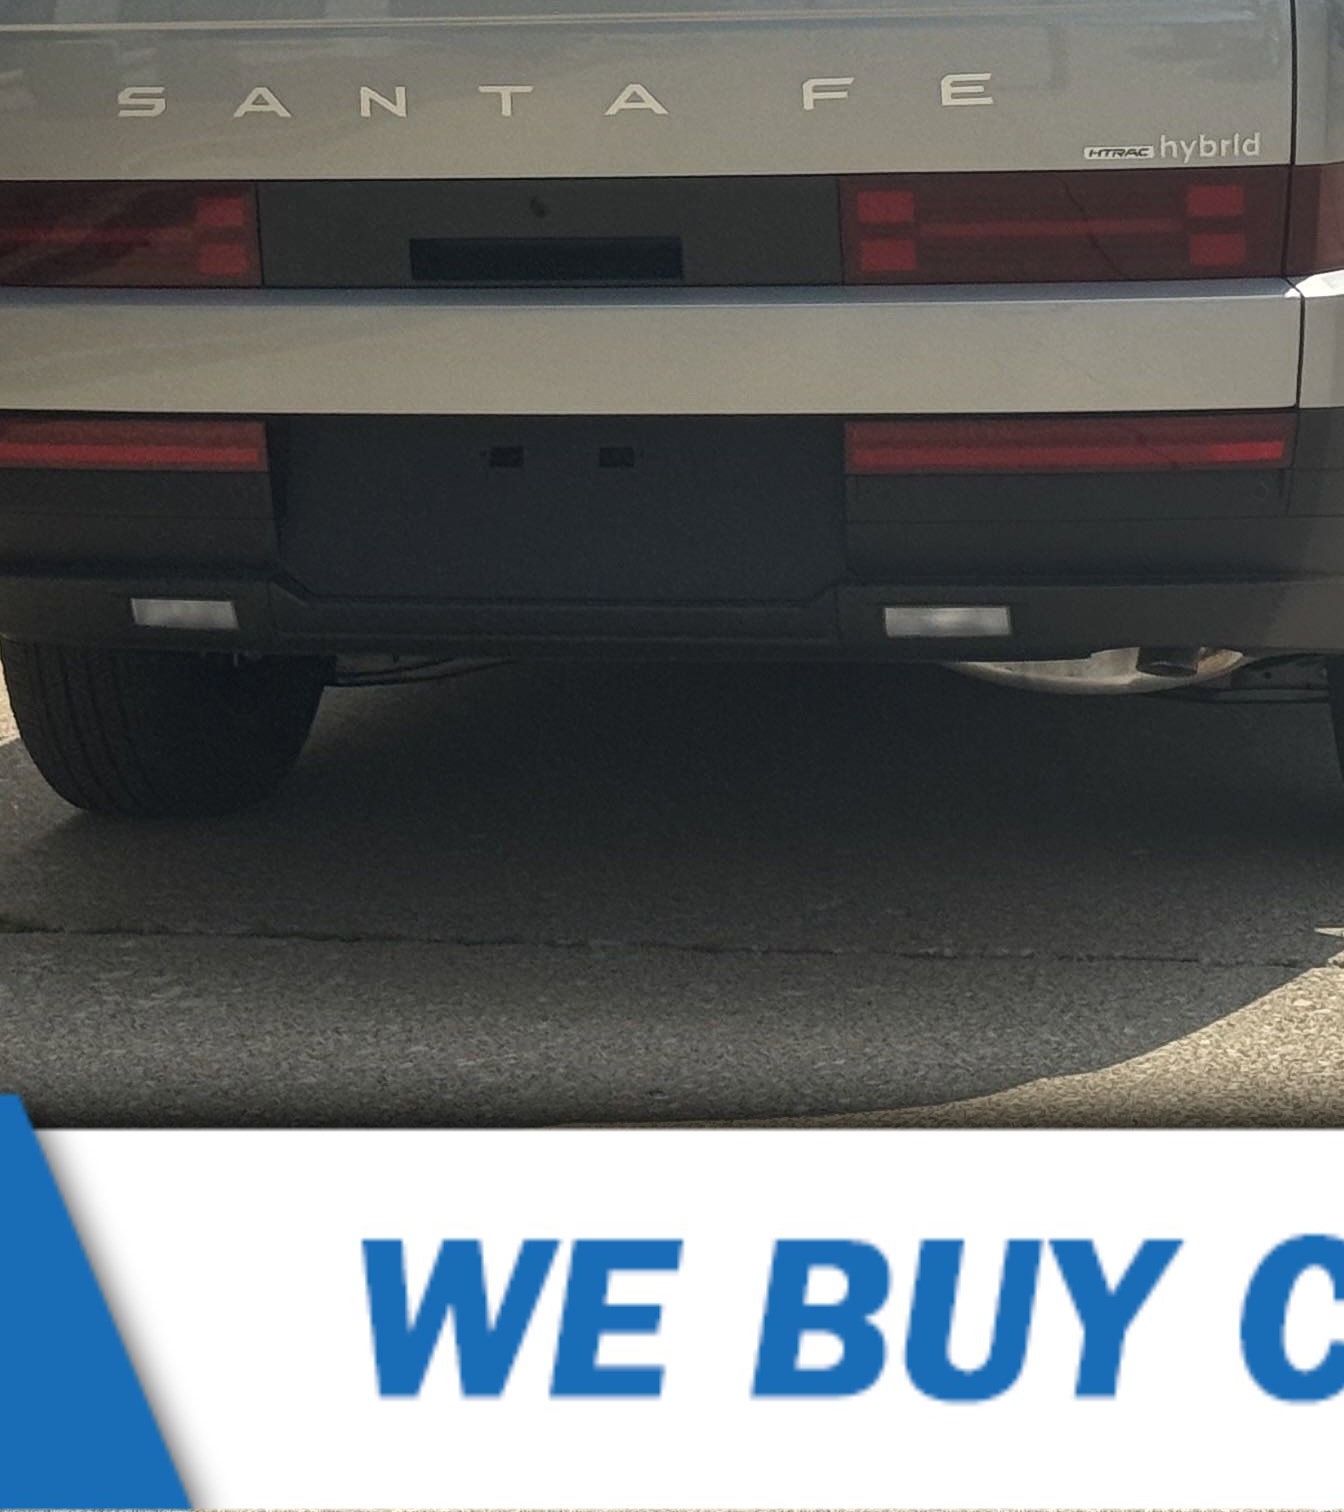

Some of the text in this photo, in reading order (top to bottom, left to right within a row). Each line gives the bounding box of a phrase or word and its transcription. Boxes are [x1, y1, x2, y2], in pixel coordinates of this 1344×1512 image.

[116, 72, 993, 119] SANTA FE
[1088, 147, 1151, 158] HTRAC
[1159, 132, 1261, 164] hybrid
